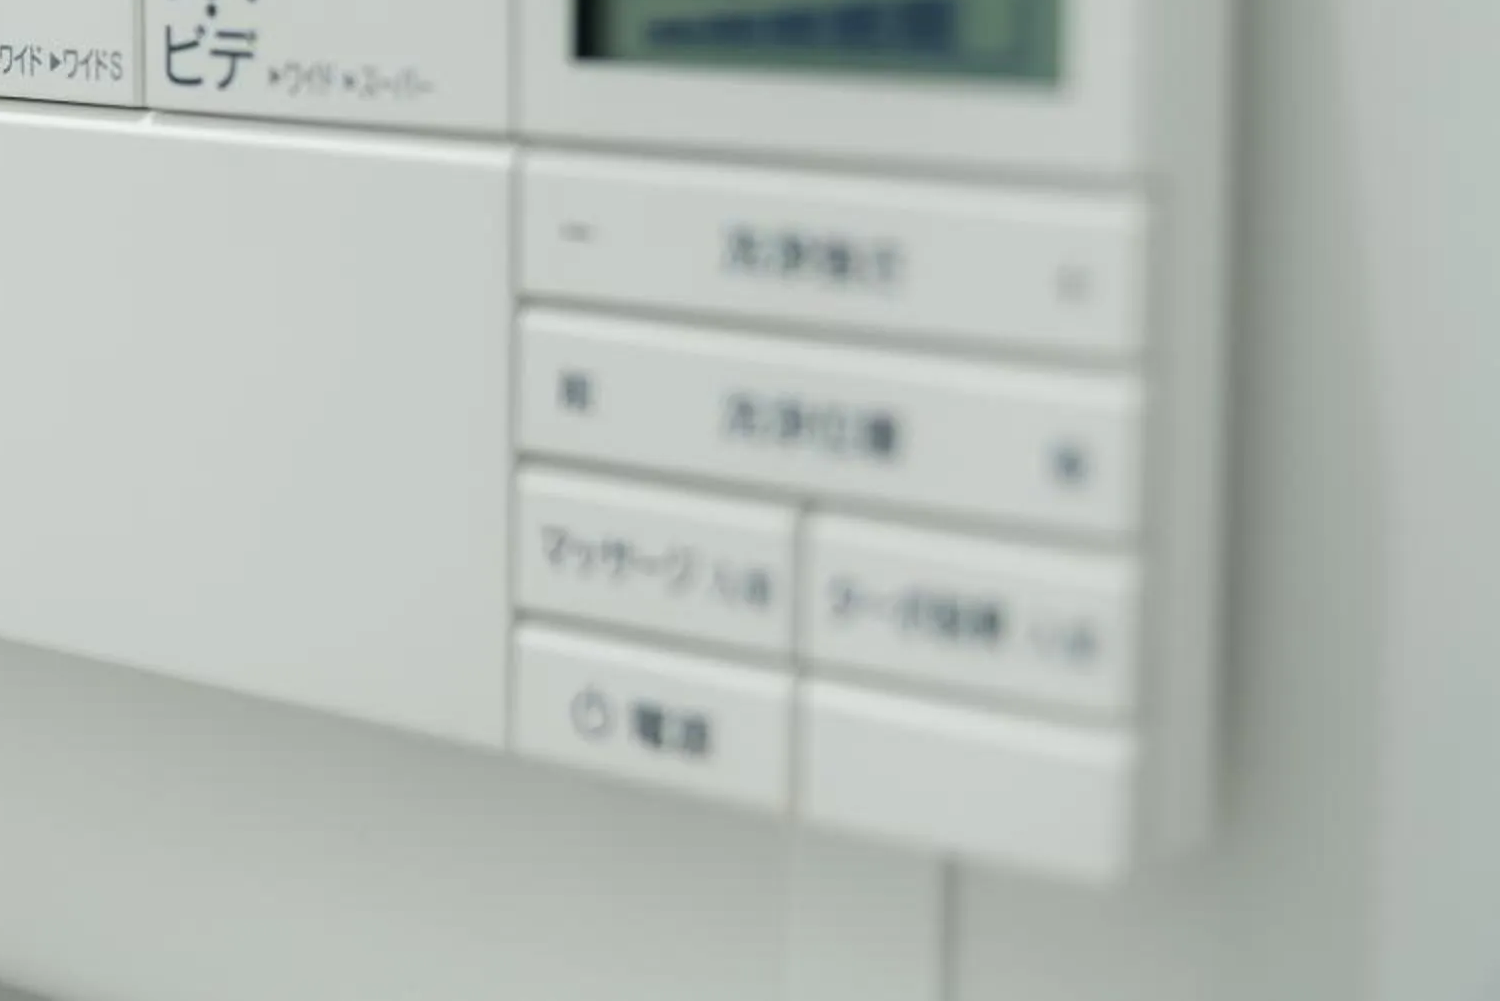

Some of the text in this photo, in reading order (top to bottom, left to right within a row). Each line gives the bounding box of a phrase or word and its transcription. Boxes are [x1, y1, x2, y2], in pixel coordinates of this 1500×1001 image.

[0, 42, 44, 79] ワイド
[62, 46, 123, 83] ワイドS
[164, 23, 258, 92] ビデ
